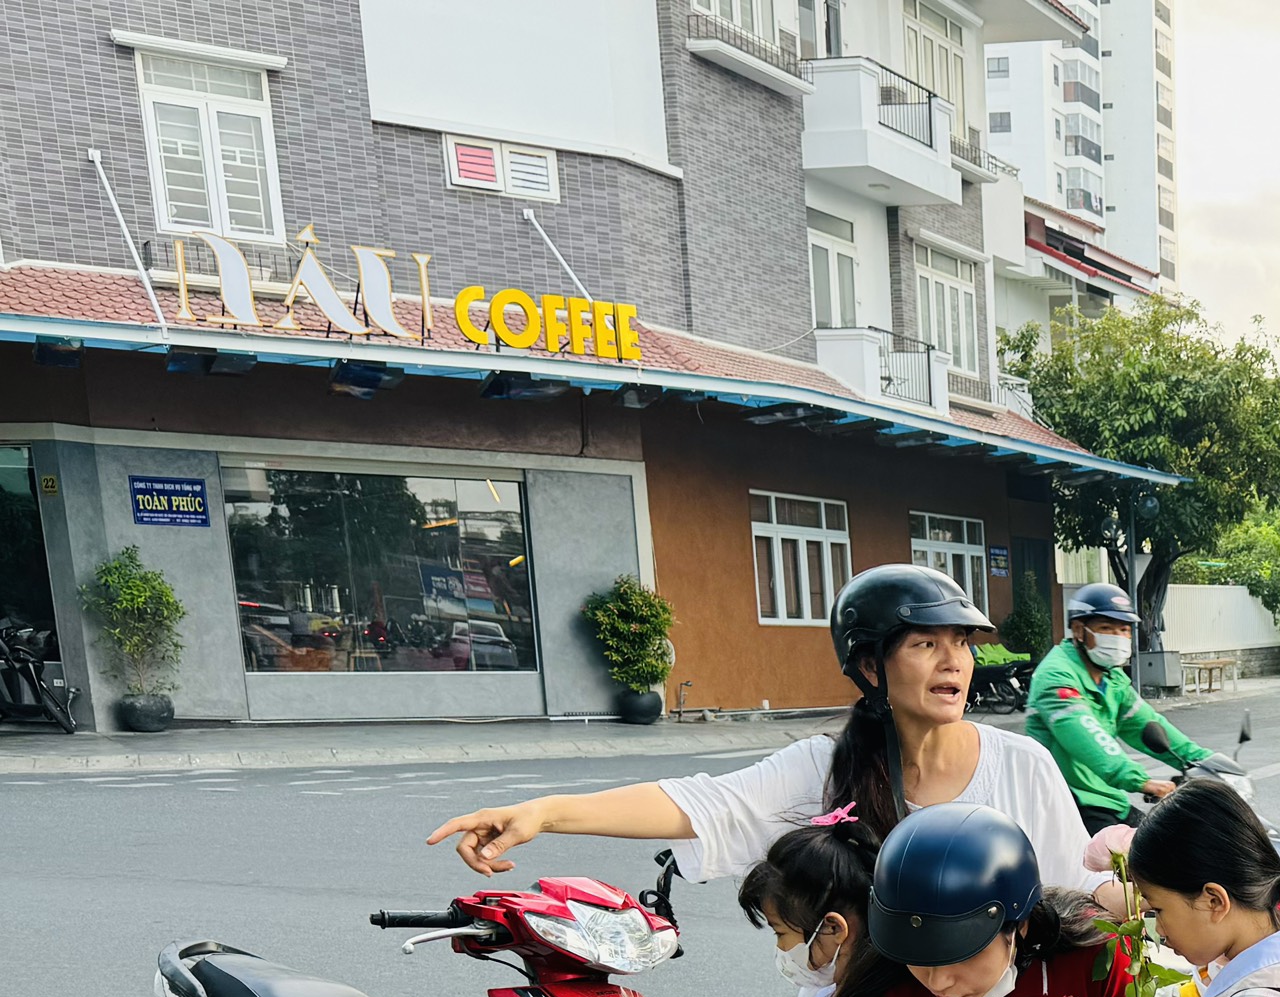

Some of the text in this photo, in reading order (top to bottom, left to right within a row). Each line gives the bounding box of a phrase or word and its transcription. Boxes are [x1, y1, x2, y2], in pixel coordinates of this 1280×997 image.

[454, 286, 641, 360] COFFEE
[43, 477, 56, 489] 22
[136, 491, 204, 512] TOÀN PHÚC
[1081, 715, 1120, 756] Grab
